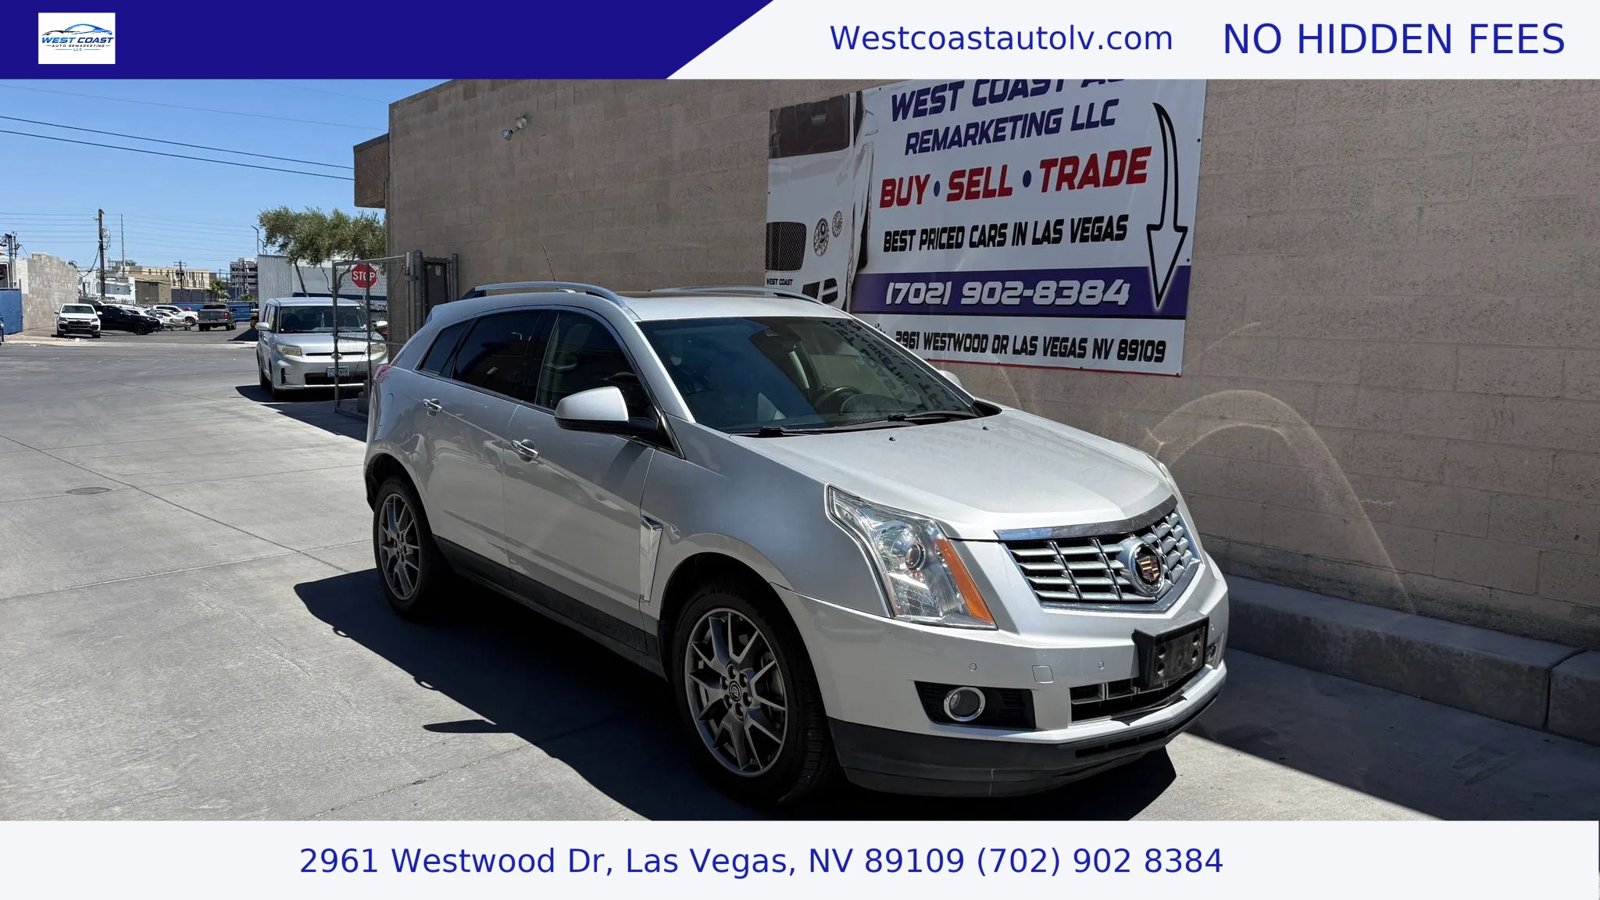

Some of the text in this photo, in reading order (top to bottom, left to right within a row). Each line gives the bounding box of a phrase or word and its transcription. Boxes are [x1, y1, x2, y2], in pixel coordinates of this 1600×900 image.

[892, 81, 965, 122] WEST
[905, 98, 1119, 156] REMARKETING LLC
[879, 146, 1152, 208] BUY SELL TRADE
[883, 214, 1129, 253] BEST PRICED CARS IN LAS VEGAS
[779, 278, 793, 286] COAST
[886, 279, 1131, 306] (702) 902-8384
[923, 332, 989, 354] WESTWOOD
[991, 334, 1009, 355] DR
[1012, 335, 1038, 357] LAS
[1043, 336, 1088, 359] VEGAS
[1092, 338, 1114, 360] NV
[1117, 339, 1167, 363] 89109
